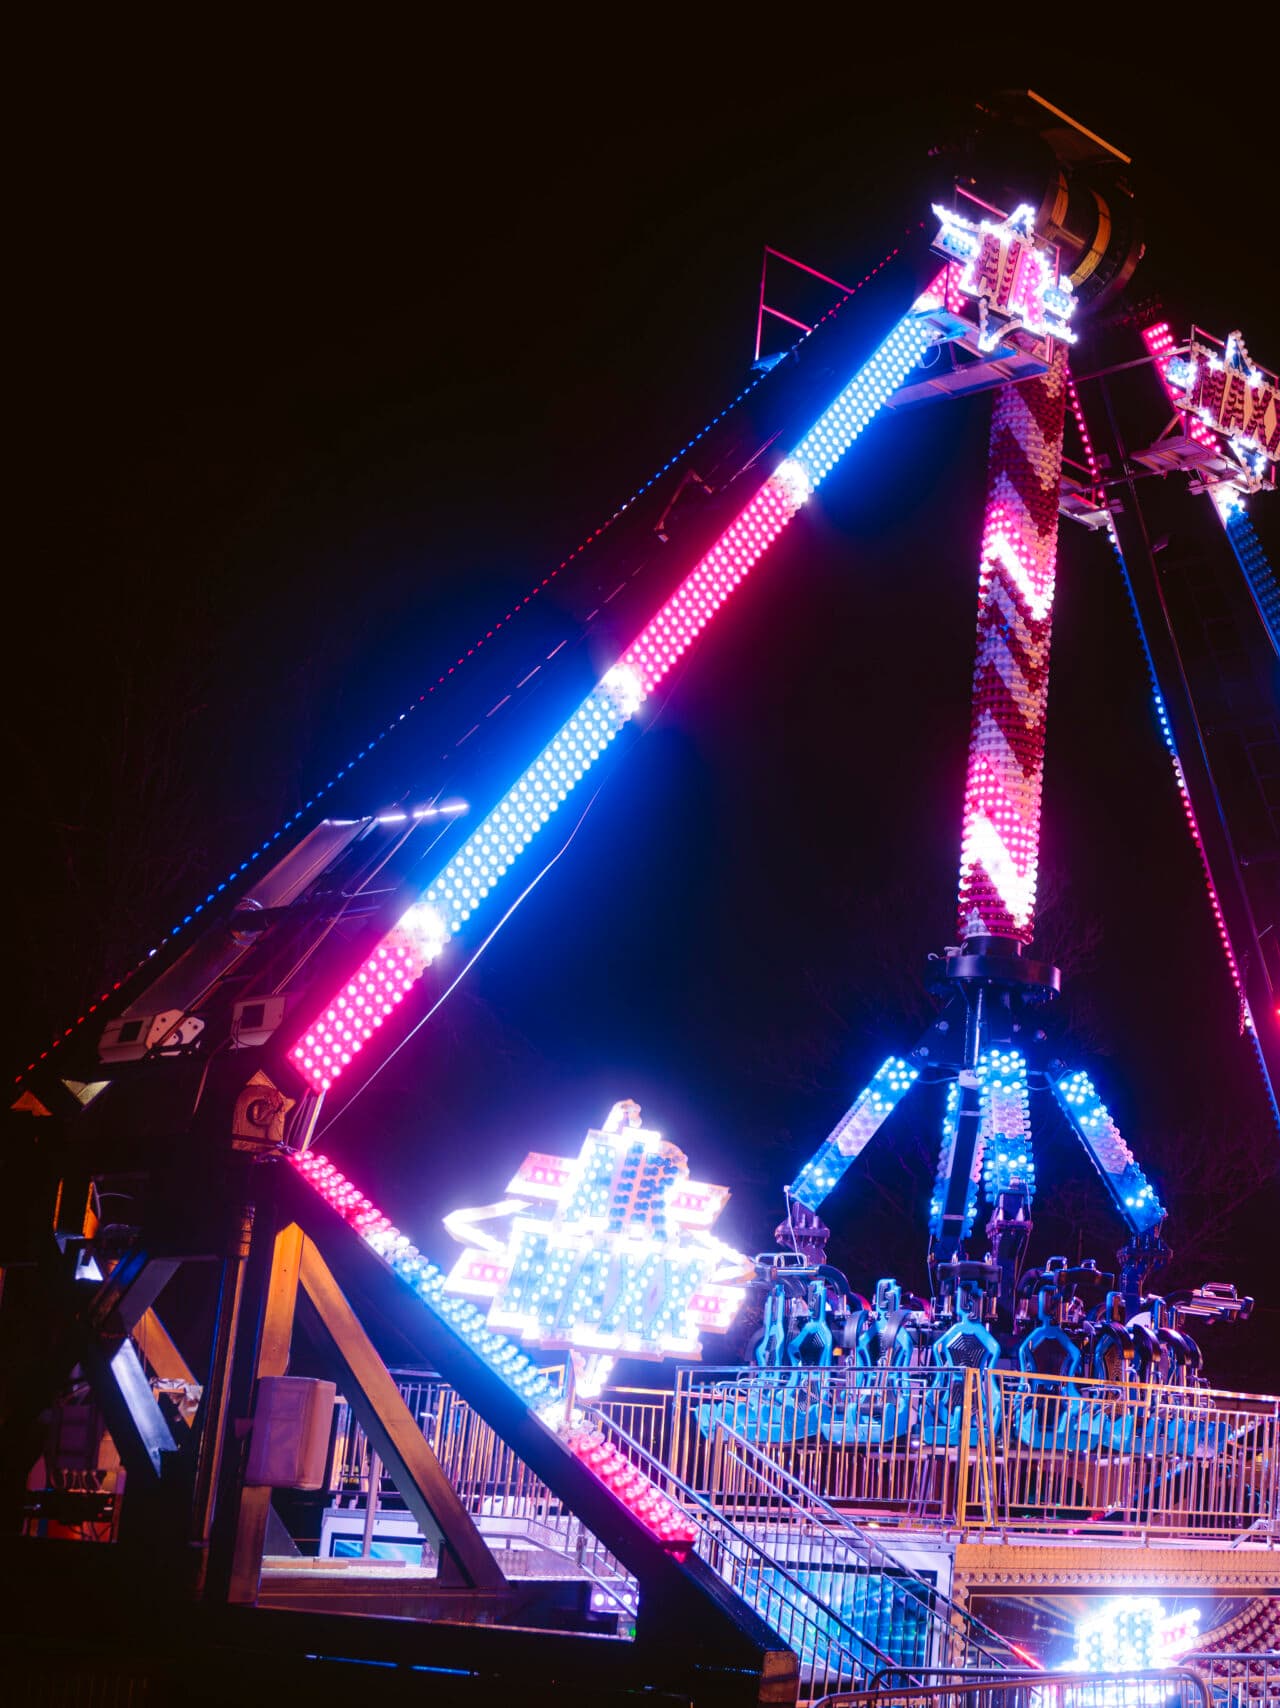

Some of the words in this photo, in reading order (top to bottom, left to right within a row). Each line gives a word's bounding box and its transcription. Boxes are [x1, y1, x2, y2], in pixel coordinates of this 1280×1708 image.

[969, 234, 1044, 323] AIR
[564, 1142, 679, 1243] AIR
[502, 1231, 704, 1340] MAXX
